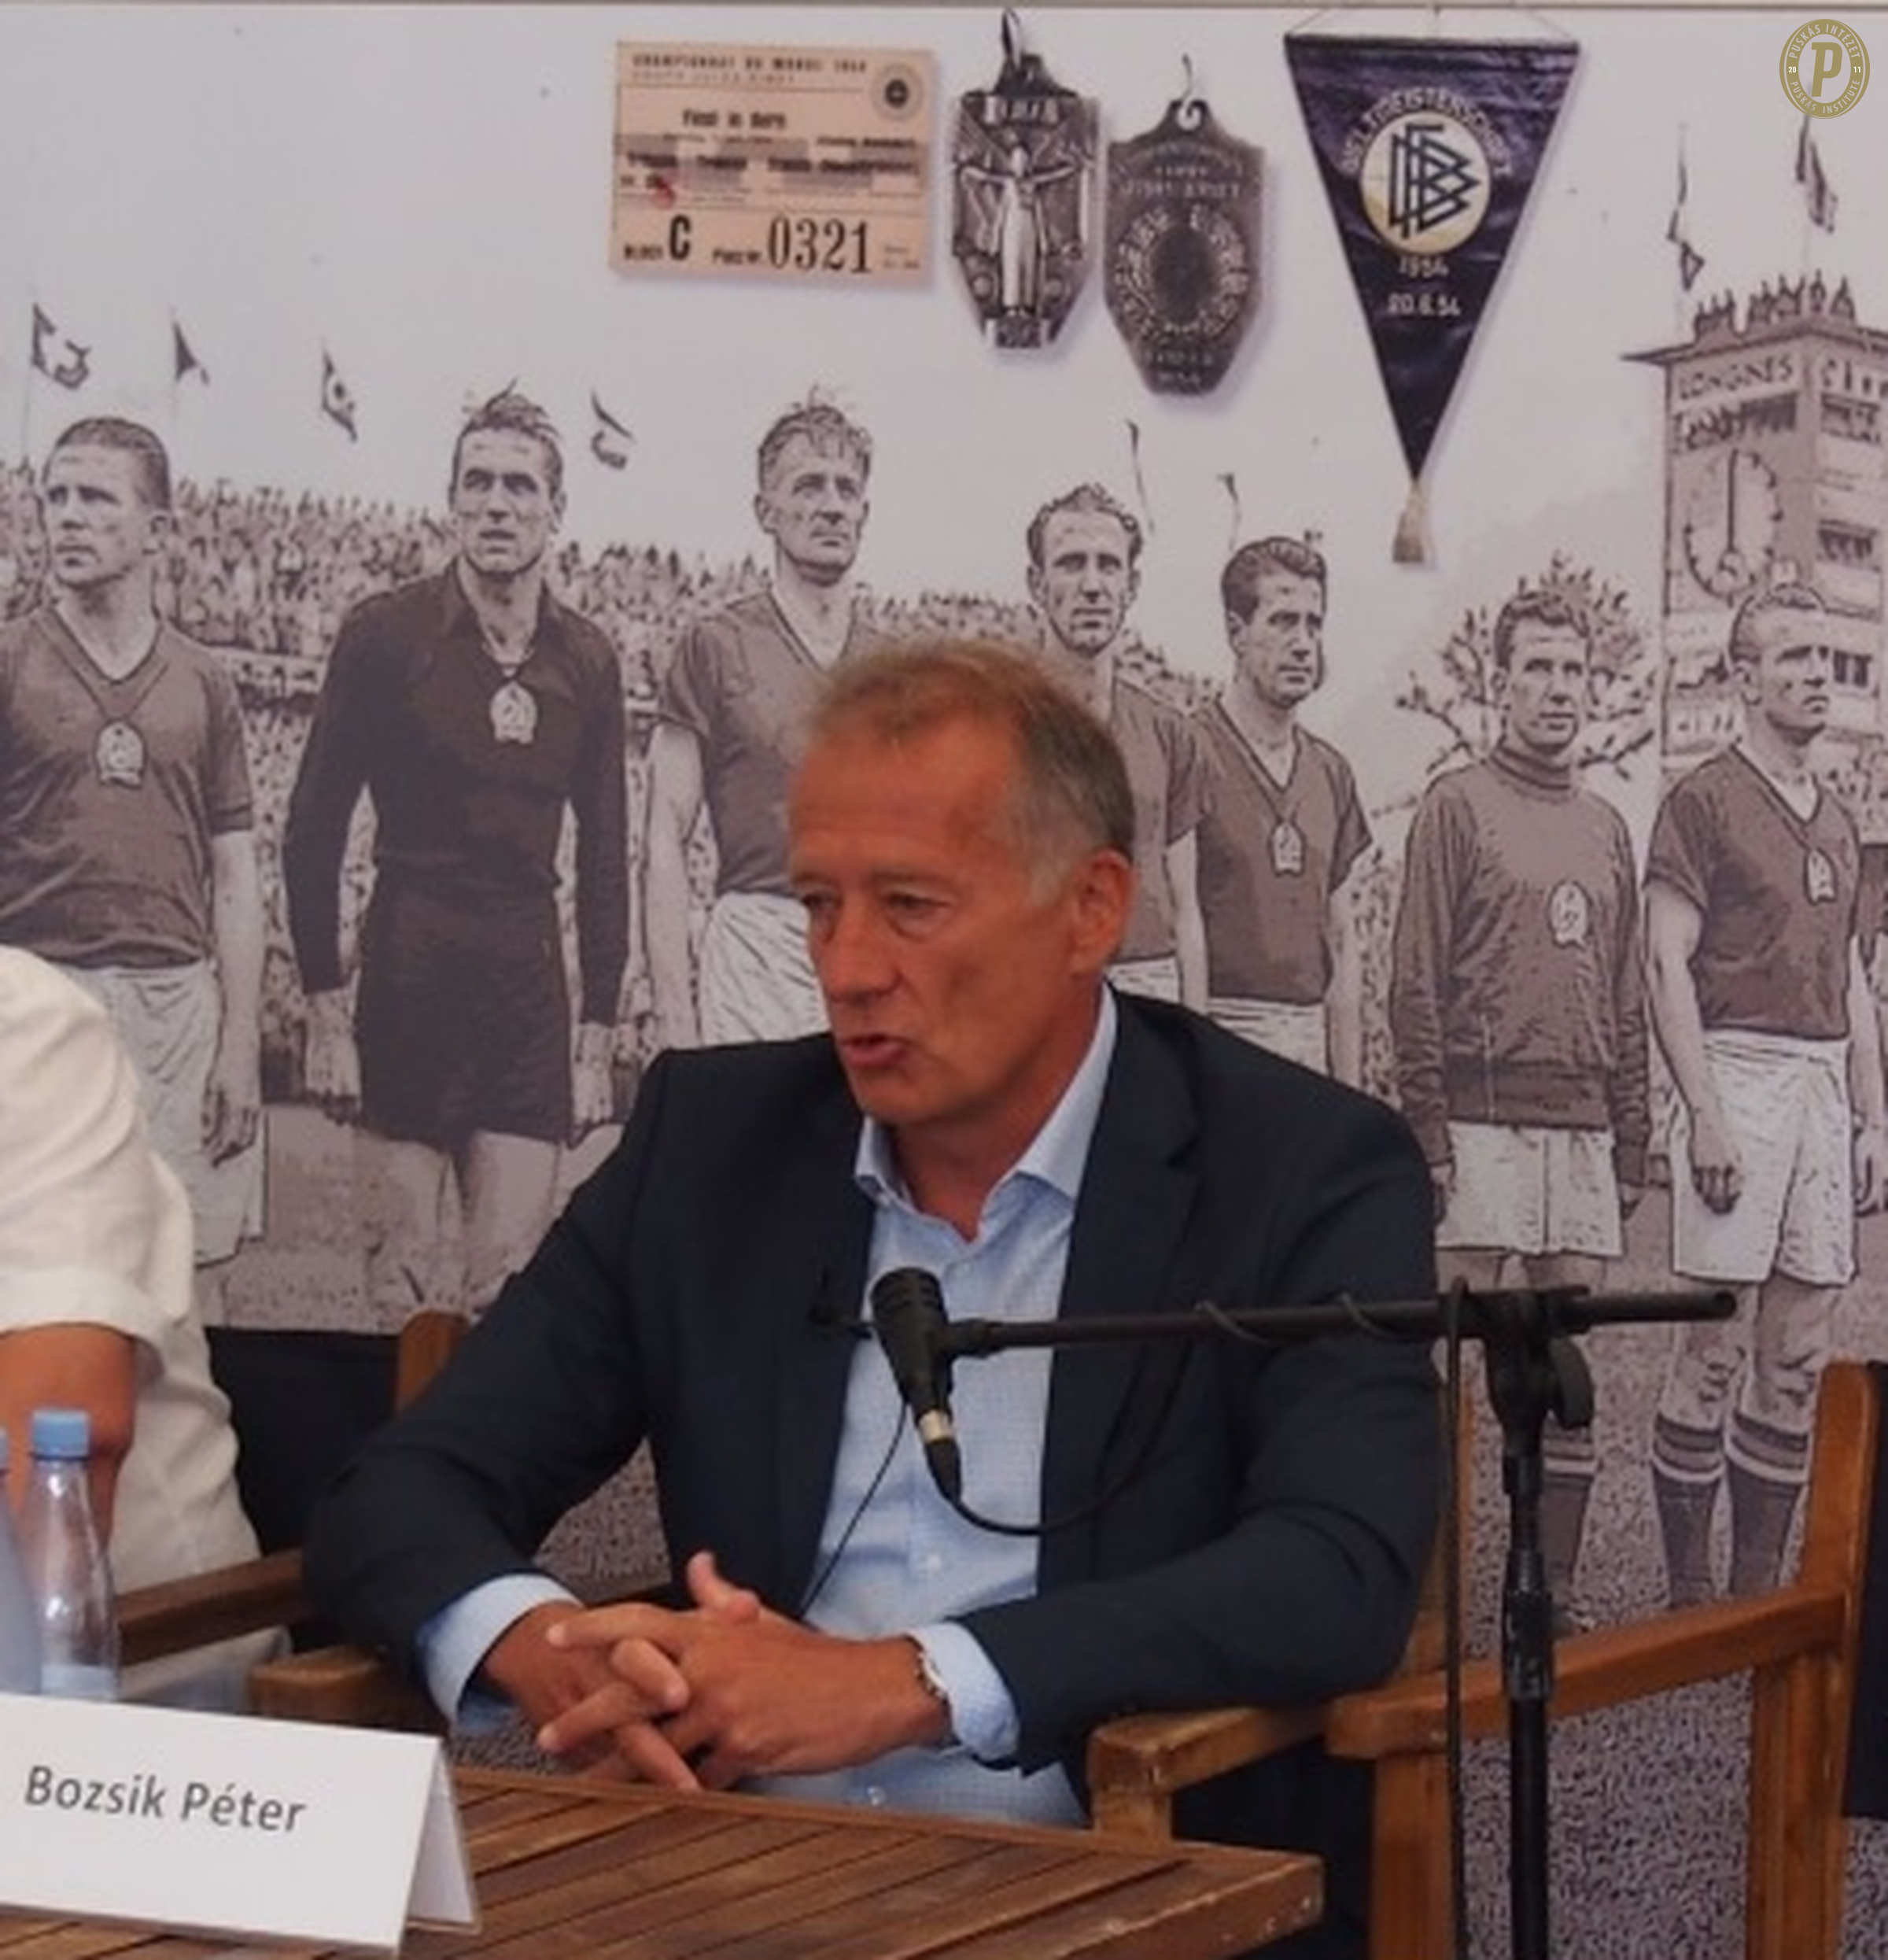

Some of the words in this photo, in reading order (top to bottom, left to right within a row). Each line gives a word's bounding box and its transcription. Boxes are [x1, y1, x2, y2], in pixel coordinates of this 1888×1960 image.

[669, 213, 691, 260] C
[768, 215, 872, 274] 0321
[24, 1765, 165, 1818] Bozsik
[181, 1781, 307, 1833] Péter
